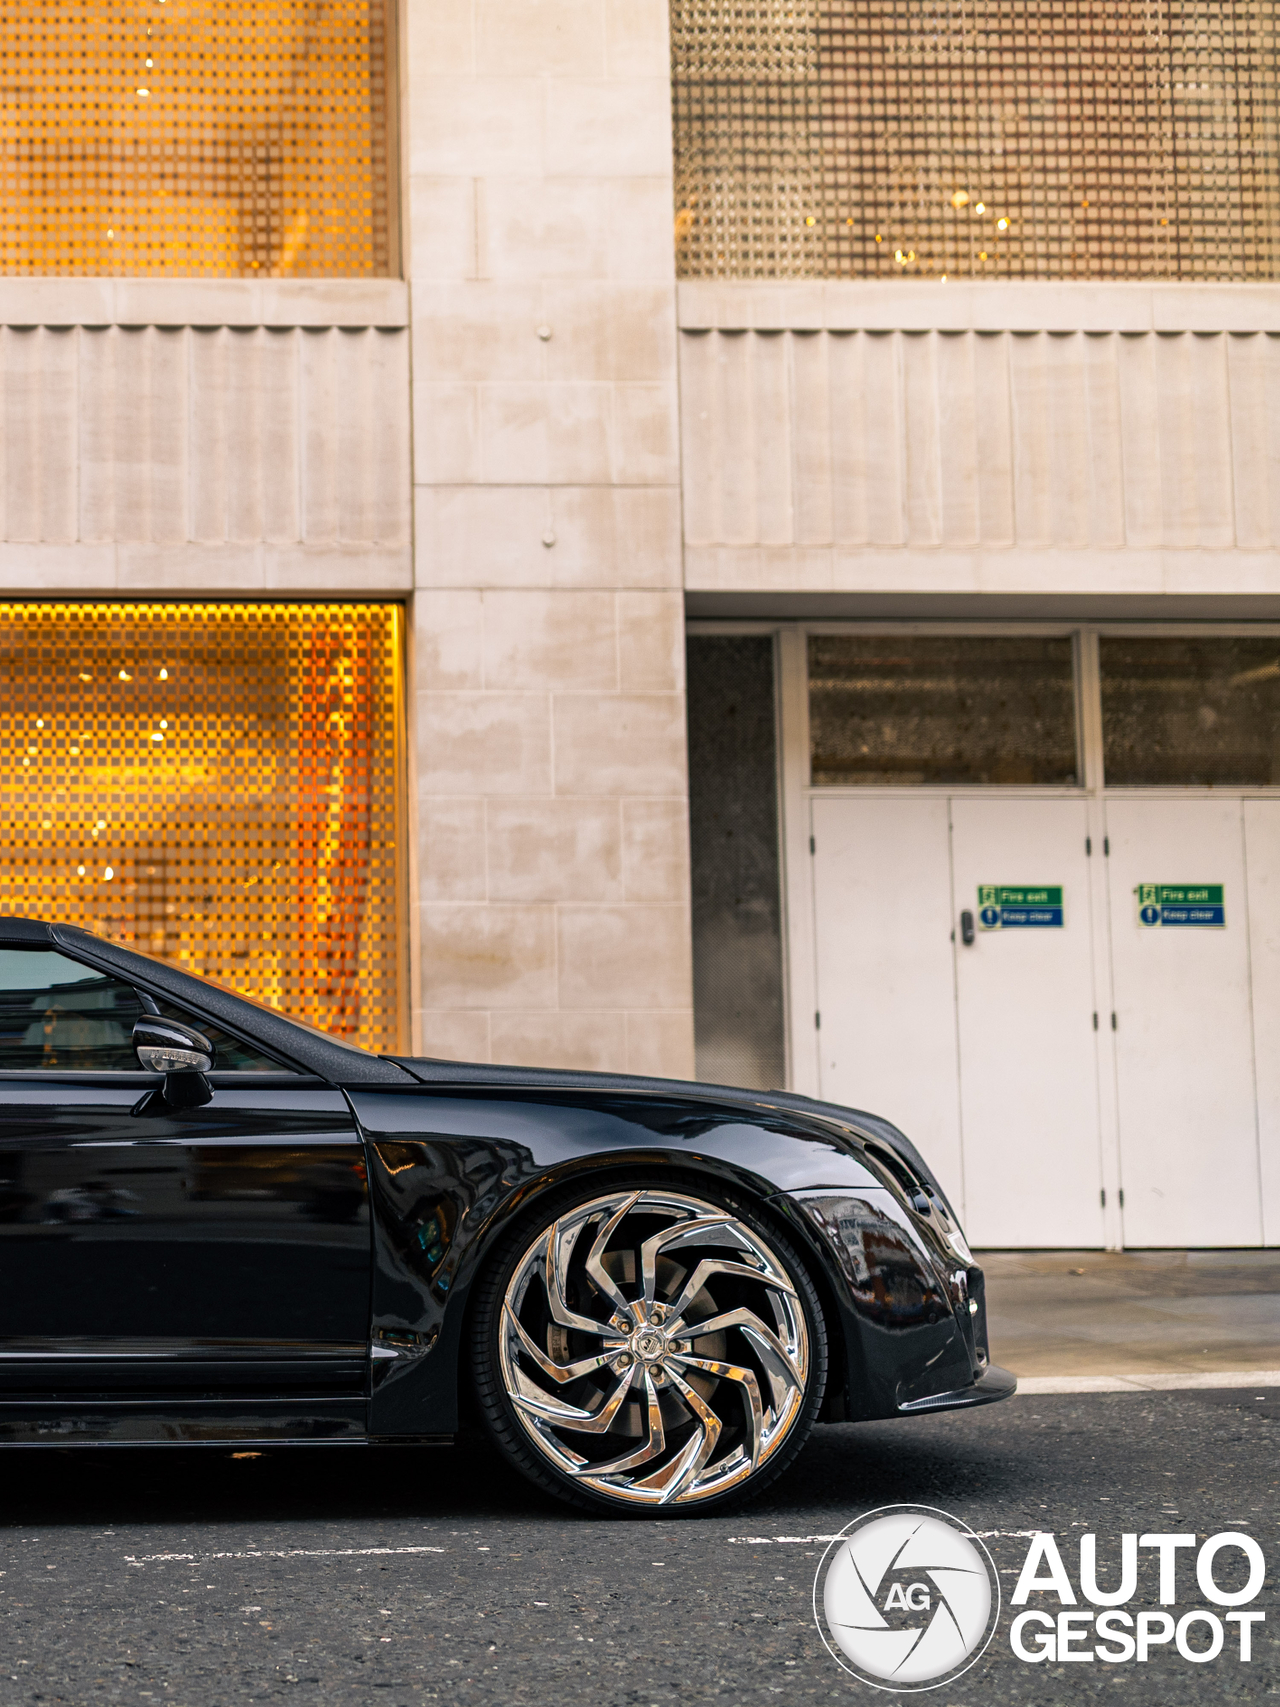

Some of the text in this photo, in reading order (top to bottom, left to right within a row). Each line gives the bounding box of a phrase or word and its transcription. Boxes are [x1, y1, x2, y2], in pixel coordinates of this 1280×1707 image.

[1002, 890, 1048, 903] Fire exit
[1162, 888, 1208, 901] Fire exit
[1002, 911, 1026, 923] Keep
[1162, 909, 1187, 922] Keep
